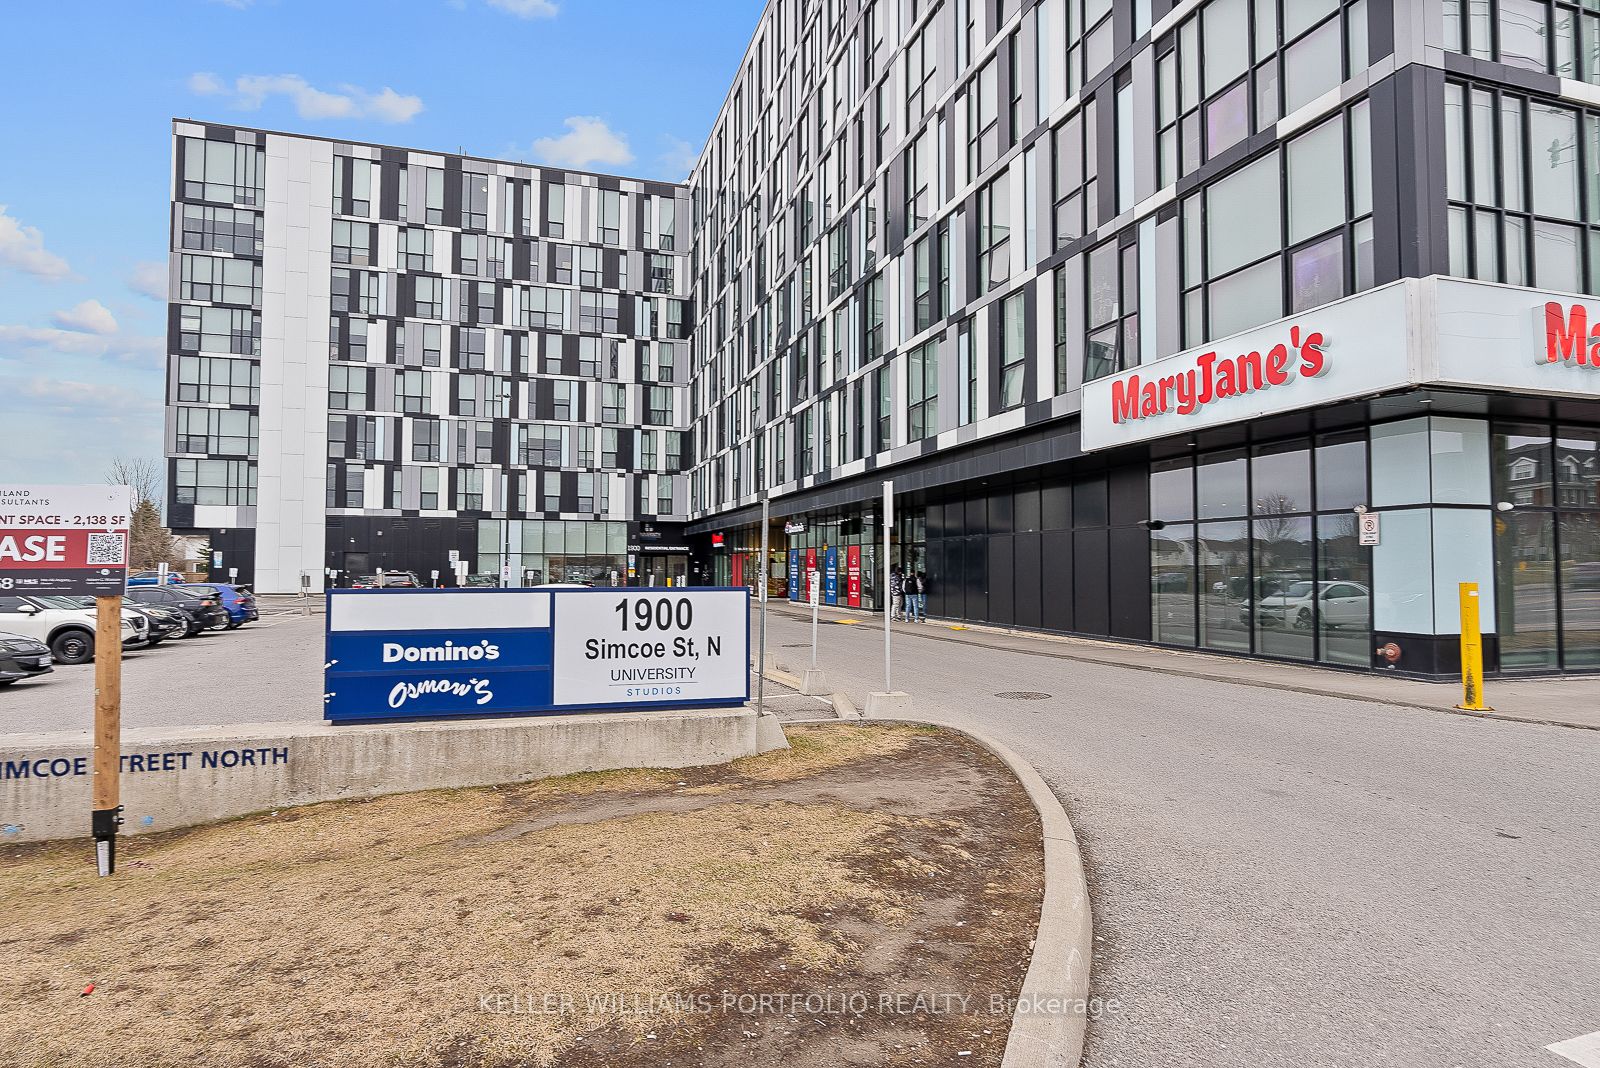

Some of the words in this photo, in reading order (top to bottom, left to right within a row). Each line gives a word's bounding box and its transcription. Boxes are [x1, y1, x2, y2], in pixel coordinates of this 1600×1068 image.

[1111, 325, 1324, 424] MaryJane's
[19, 515, 61, 525] SPACE
[73, 515, 107, 527] 2,138
[111, 515, 126, 525] SF
[0, 535, 67, 562] ASE
[615, 597, 693, 632] 1900
[382, 639, 500, 663] Domino's
[584, 638, 666, 660] Simcoe
[672, 637, 700, 661] St,
[707, 636, 721, 657] N
[610, 667, 697, 682] UNIVERSITY
[626, 686, 681, 697] STUDIOS
[119, 752, 192, 773] TREET
[201, 747, 288, 769] NORTH
